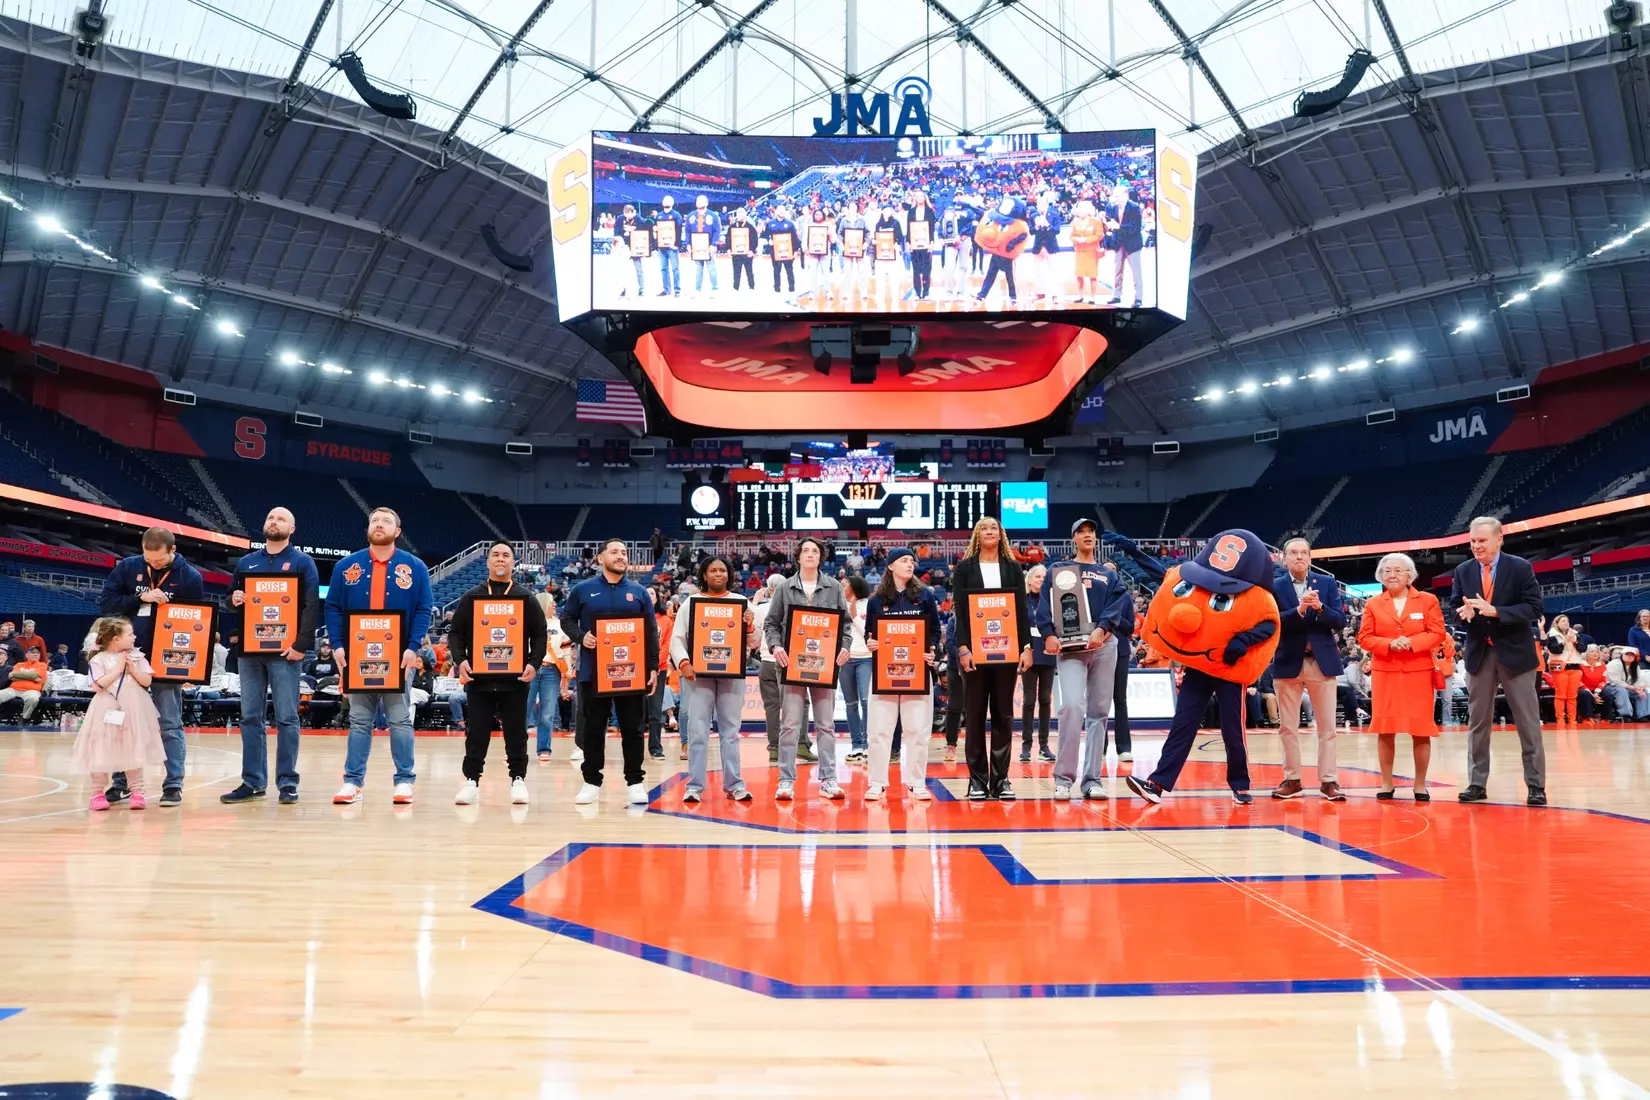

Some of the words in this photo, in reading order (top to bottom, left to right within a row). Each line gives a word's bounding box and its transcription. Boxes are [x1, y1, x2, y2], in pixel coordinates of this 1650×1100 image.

[813, 93, 933, 137] JMA
[552, 148, 589, 245] S
[1159, 146, 1192, 243] S
[700, 357, 810, 385] JMA
[907, 355, 1016, 385] JMA
[235, 416, 267, 460] S
[1430, 414, 1488, 443] JMA
[306, 440, 392, 467] SYRACUSE
[848, 484, 877, 501] 13:17
[805, 496, 822, 518] 41
[901, 496, 922, 518] 30
[47, 548, 62, 557] DICK
[303, 546, 315, 554] DR.
[315, 547, 333, 556] RUTH
[333, 549, 351, 557] CHEN
[1208, 534, 1248, 572] S
[395, 564, 413, 589] S
